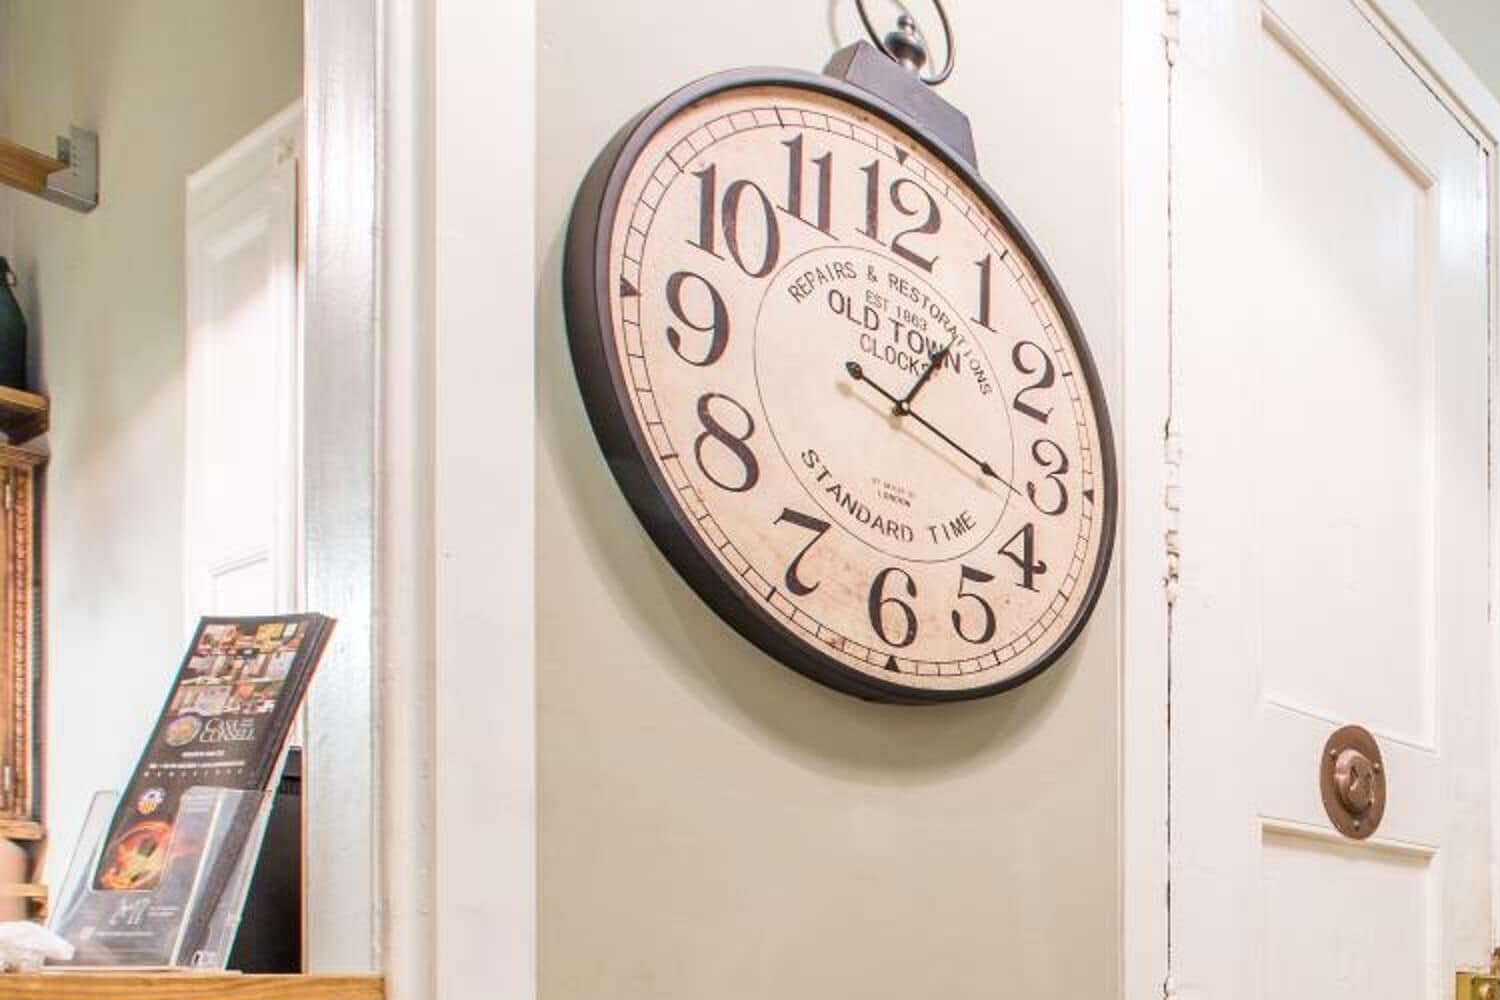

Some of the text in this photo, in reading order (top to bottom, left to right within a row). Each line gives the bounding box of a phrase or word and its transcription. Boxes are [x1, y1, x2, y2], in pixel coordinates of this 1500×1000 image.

[686, 162, 781, 279] 10
[776, 132, 840, 241] 11
[855, 159, 942, 273] 12
[666, 271, 730, 367] 9
[788, 261, 993, 397] REPAIRS & RESTORATIONS
[828, 289, 961, 375] OLD TOWN
[970, 252, 998, 333] 1
[1012, 340, 1056, 425] 2
[694, 392, 760, 493] 8
[1026, 438, 1070, 517] 3
[801, 448, 977, 545] STANDARD TIME
[773, 507, 832, 597] 7
[997, 521, 1048, 593] 4
[867, 567, 918, 648] 6
[951, 564, 997, 645] 5
